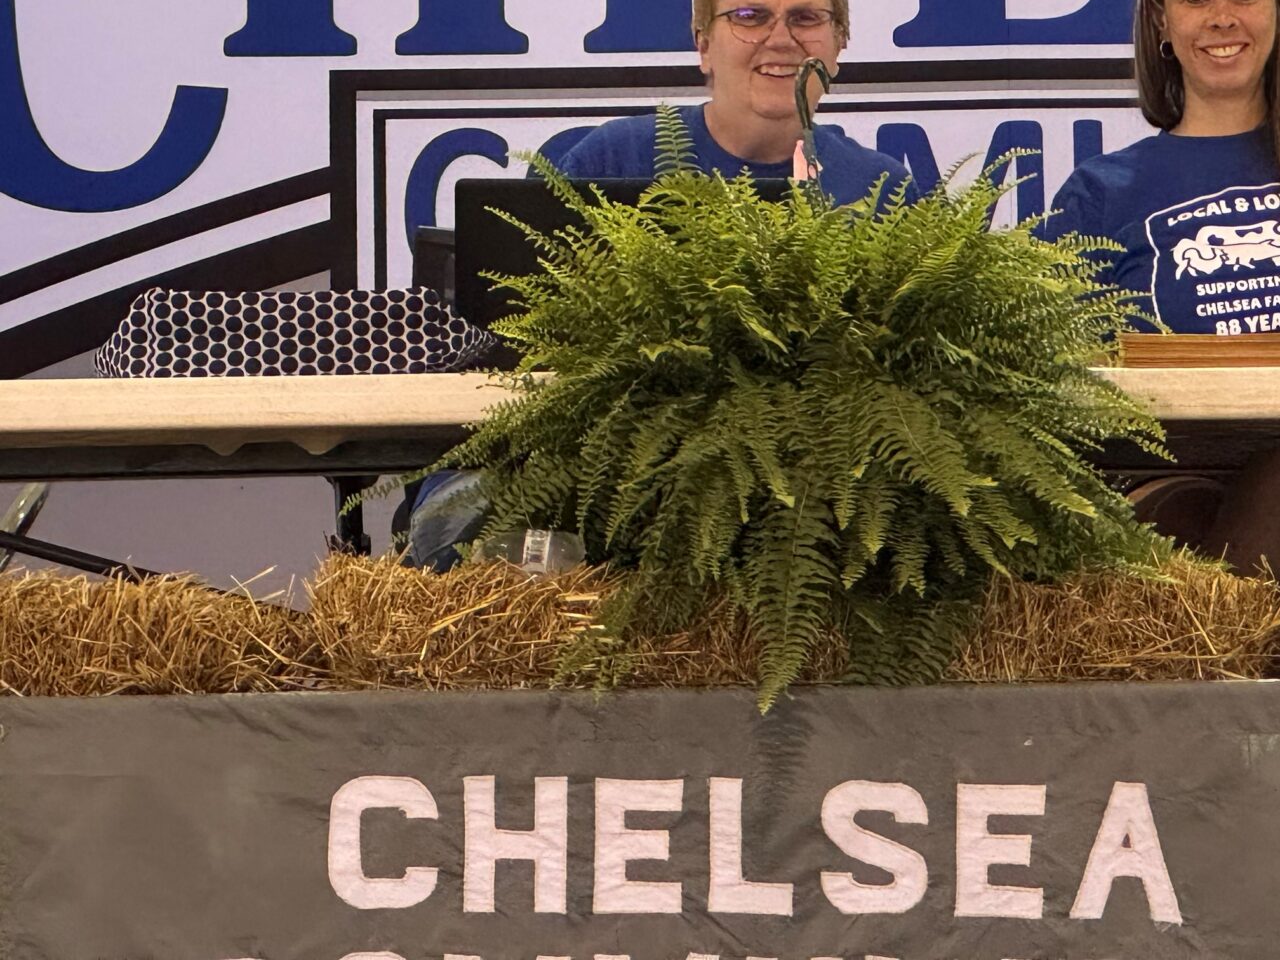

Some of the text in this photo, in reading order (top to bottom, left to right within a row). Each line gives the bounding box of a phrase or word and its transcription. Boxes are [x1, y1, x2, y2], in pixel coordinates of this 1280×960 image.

[1167, 200, 1232, 227] LOCAL
[1234, 197, 1249, 212] &
[1196, 297, 1262, 317] CHELSEA
[1215, 319, 1242, 336] 88
[328, 776, 1183, 926] CHELSEA
